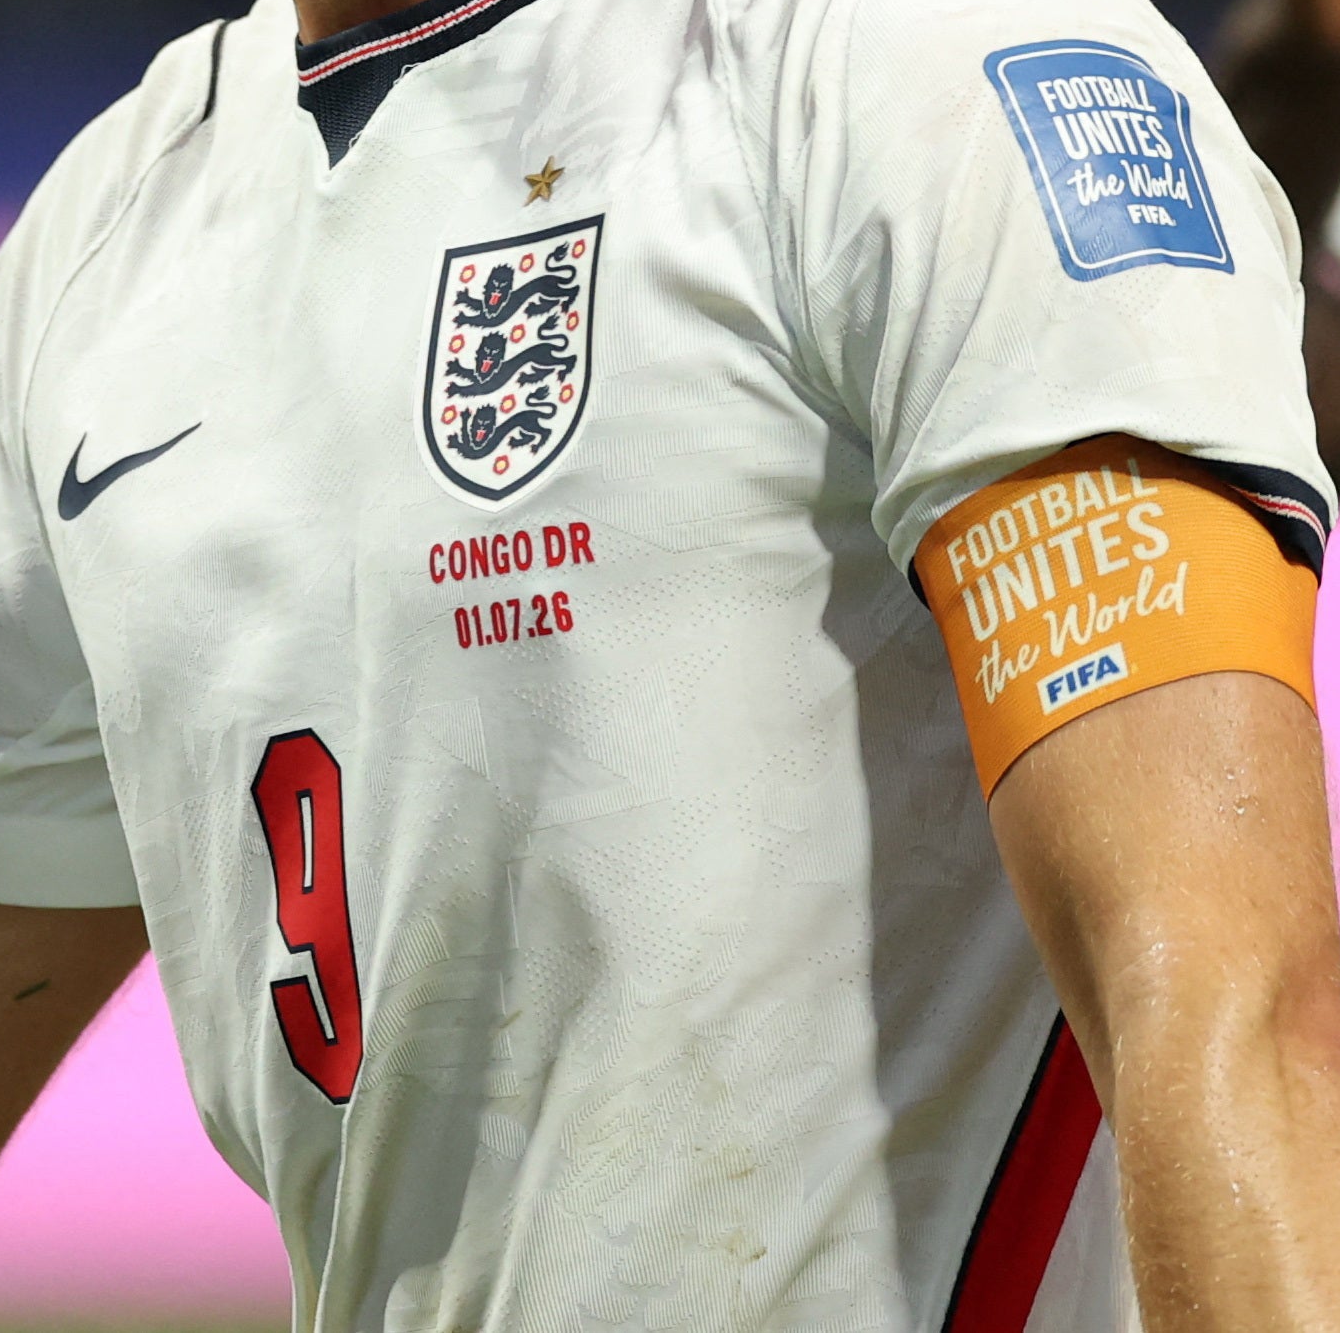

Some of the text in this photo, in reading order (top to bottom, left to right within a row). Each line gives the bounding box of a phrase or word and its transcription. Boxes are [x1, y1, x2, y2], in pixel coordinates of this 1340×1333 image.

[1037, 76, 1157, 113] FOOTBALL
[1053, 110, 1174, 160] UNITES
[1067, 159, 1193, 209] the World
[1127, 204, 1175, 226] FIFA
[946, 458, 1159, 584] FOOTBALL
[429, 522, 595, 585] CONGO DR
[962, 502, 1170, 642] UNITES
[454, 591, 574, 649] 01.07.26
[974, 562, 1189, 704] the World
[1046, 654, 1121, 704] FIFA
[250, 727, 364, 1106] 9
